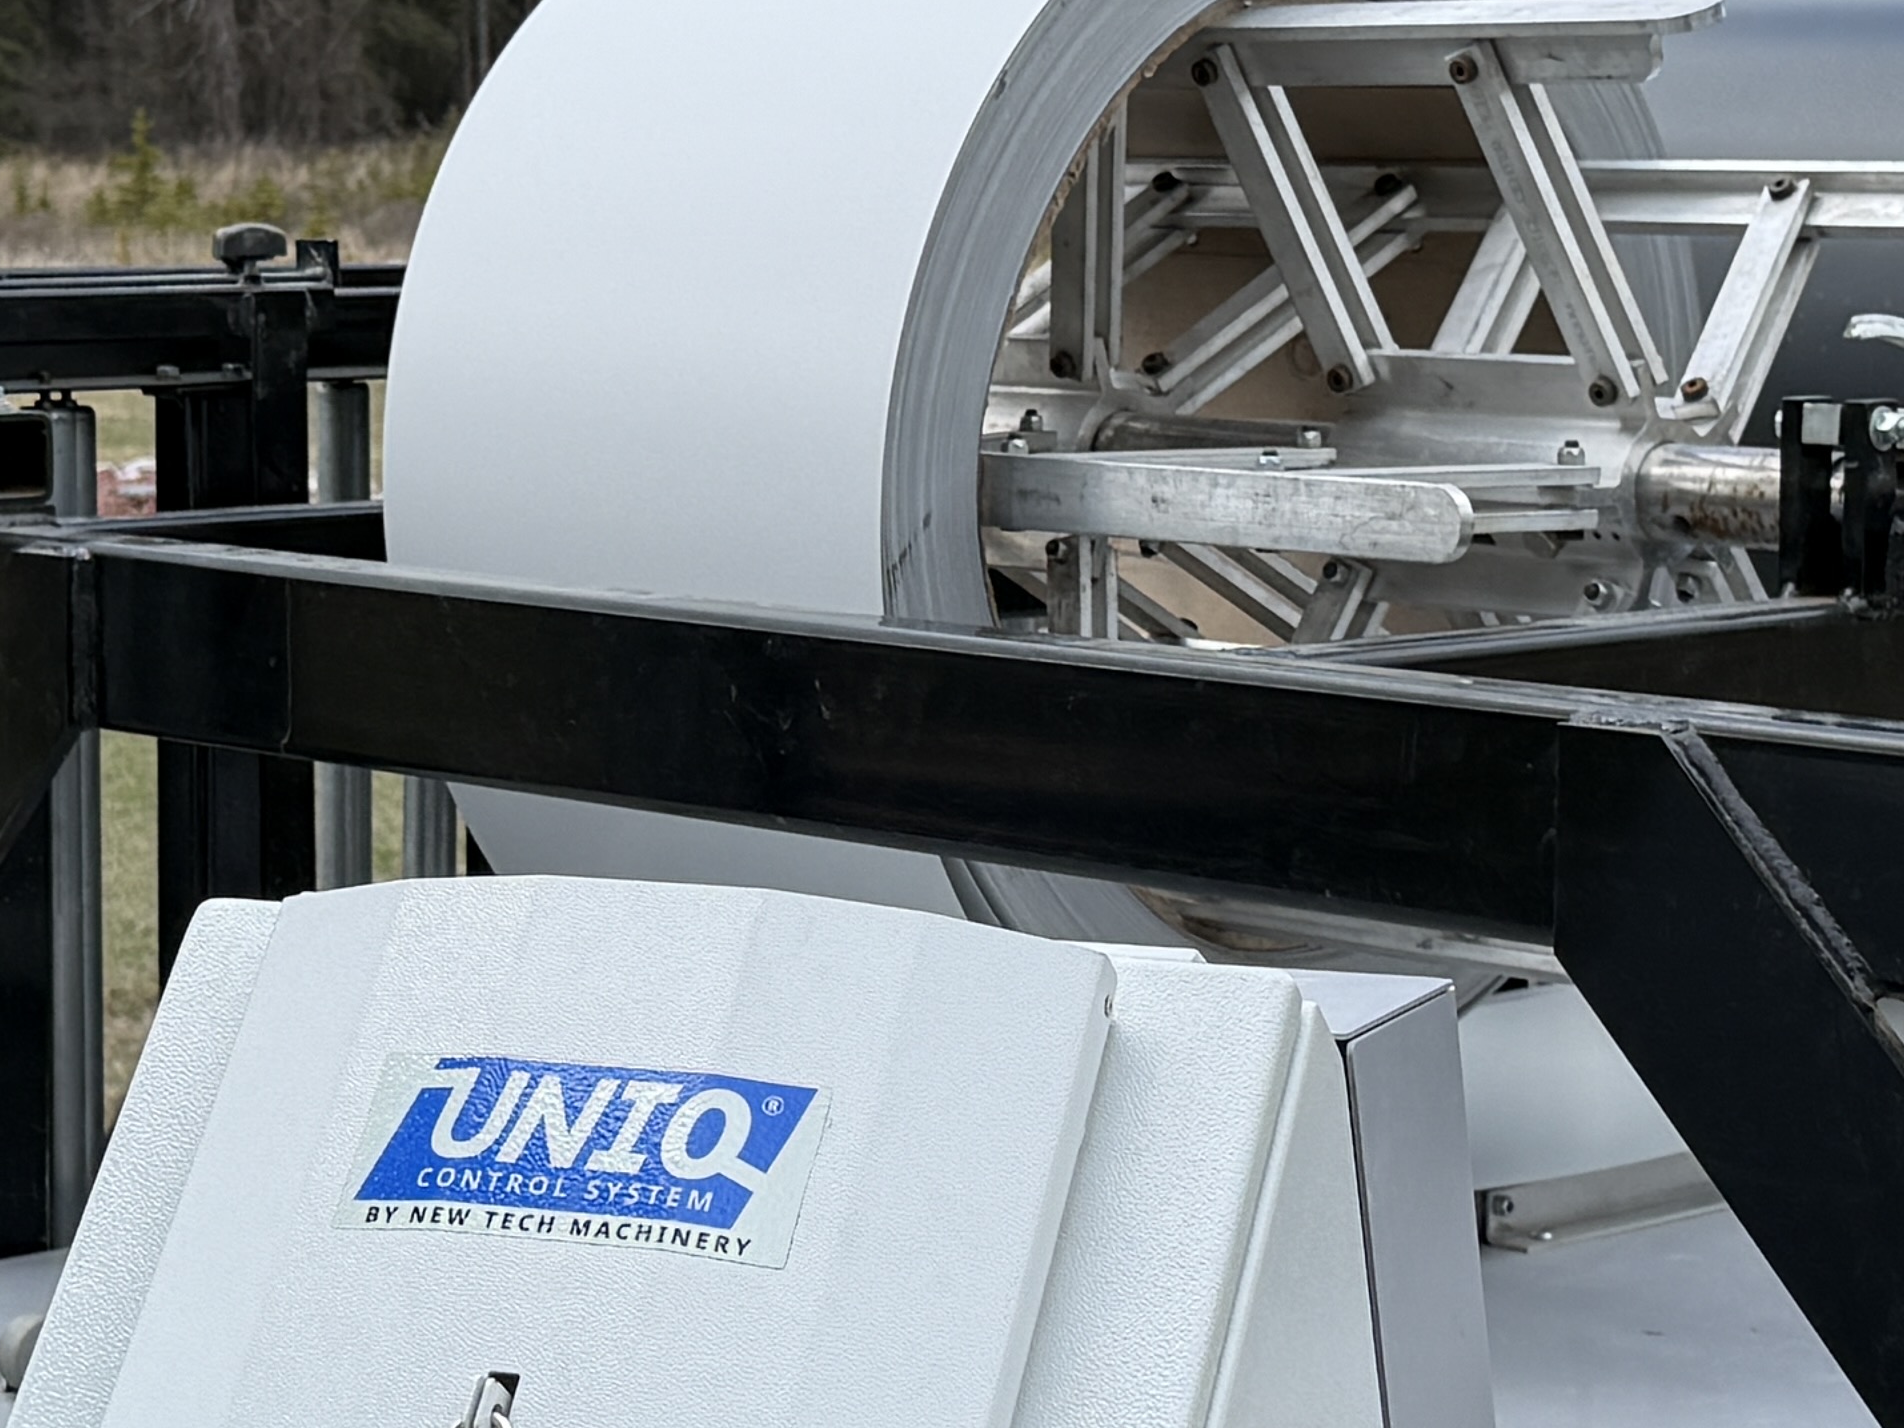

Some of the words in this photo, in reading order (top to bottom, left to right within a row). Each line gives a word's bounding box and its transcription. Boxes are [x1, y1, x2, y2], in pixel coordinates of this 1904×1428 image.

[416, 1167, 568, 1199] CONTROL
[583, 1179, 714, 1214] SYSTEM
[364, 1206, 399, 1225] BY
[408, 1206, 472, 1227] NEW
[483, 1211, 556, 1235] TECH
[570, 1219, 754, 1258] MACHINERY
